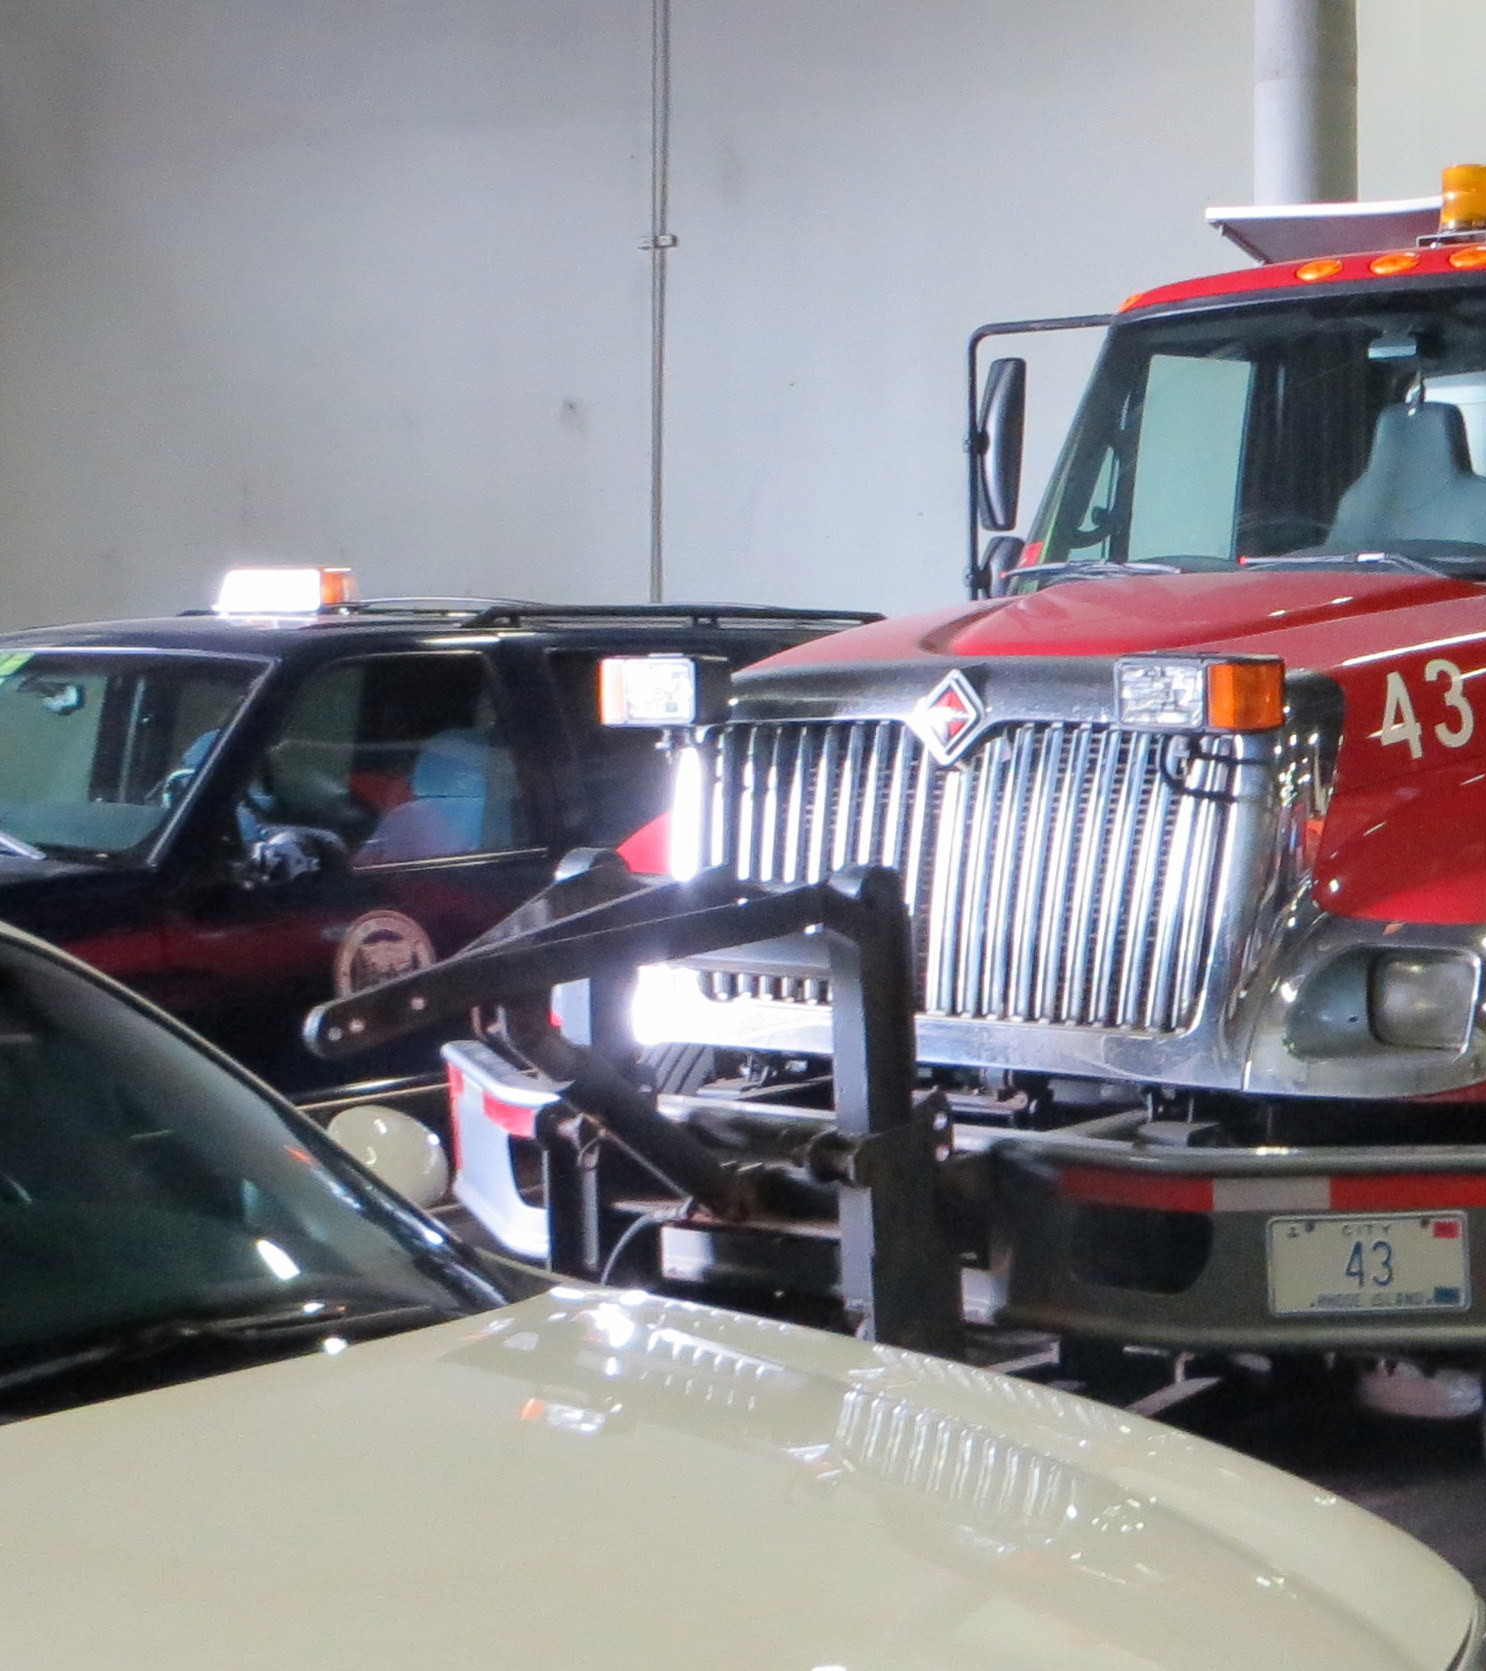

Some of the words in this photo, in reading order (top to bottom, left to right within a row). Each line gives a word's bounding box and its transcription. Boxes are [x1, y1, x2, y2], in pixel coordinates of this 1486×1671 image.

[1380, 658, 1474, 759] 43
[1341, 1222, 1393, 1236] CITY
[1344, 1240, 1394, 1288] 43
